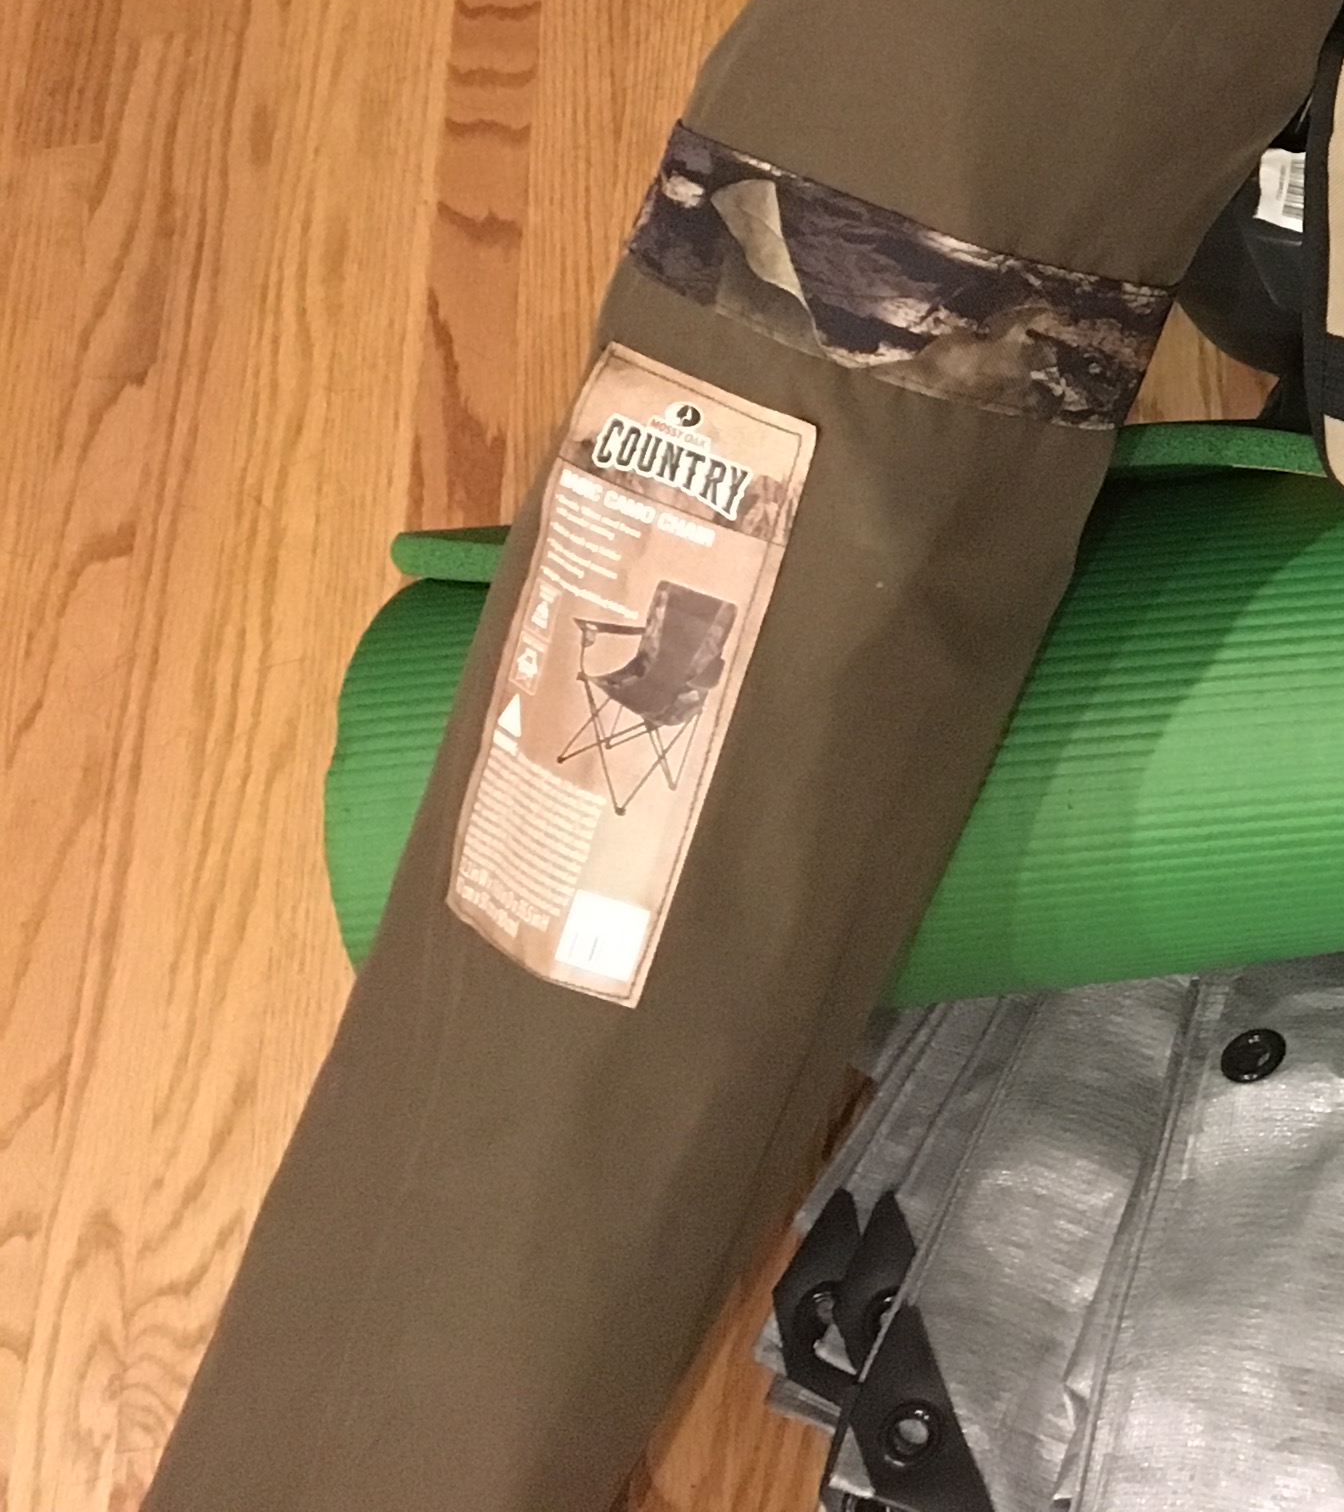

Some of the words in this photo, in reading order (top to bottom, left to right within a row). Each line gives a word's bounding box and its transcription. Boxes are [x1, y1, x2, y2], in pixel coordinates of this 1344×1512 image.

[650, 418, 682, 441] MOSSY
[596, 416, 749, 516] COUNTRY
[603, 489, 656, 524] CAMO
[657, 512, 716, 548] CHAIR
